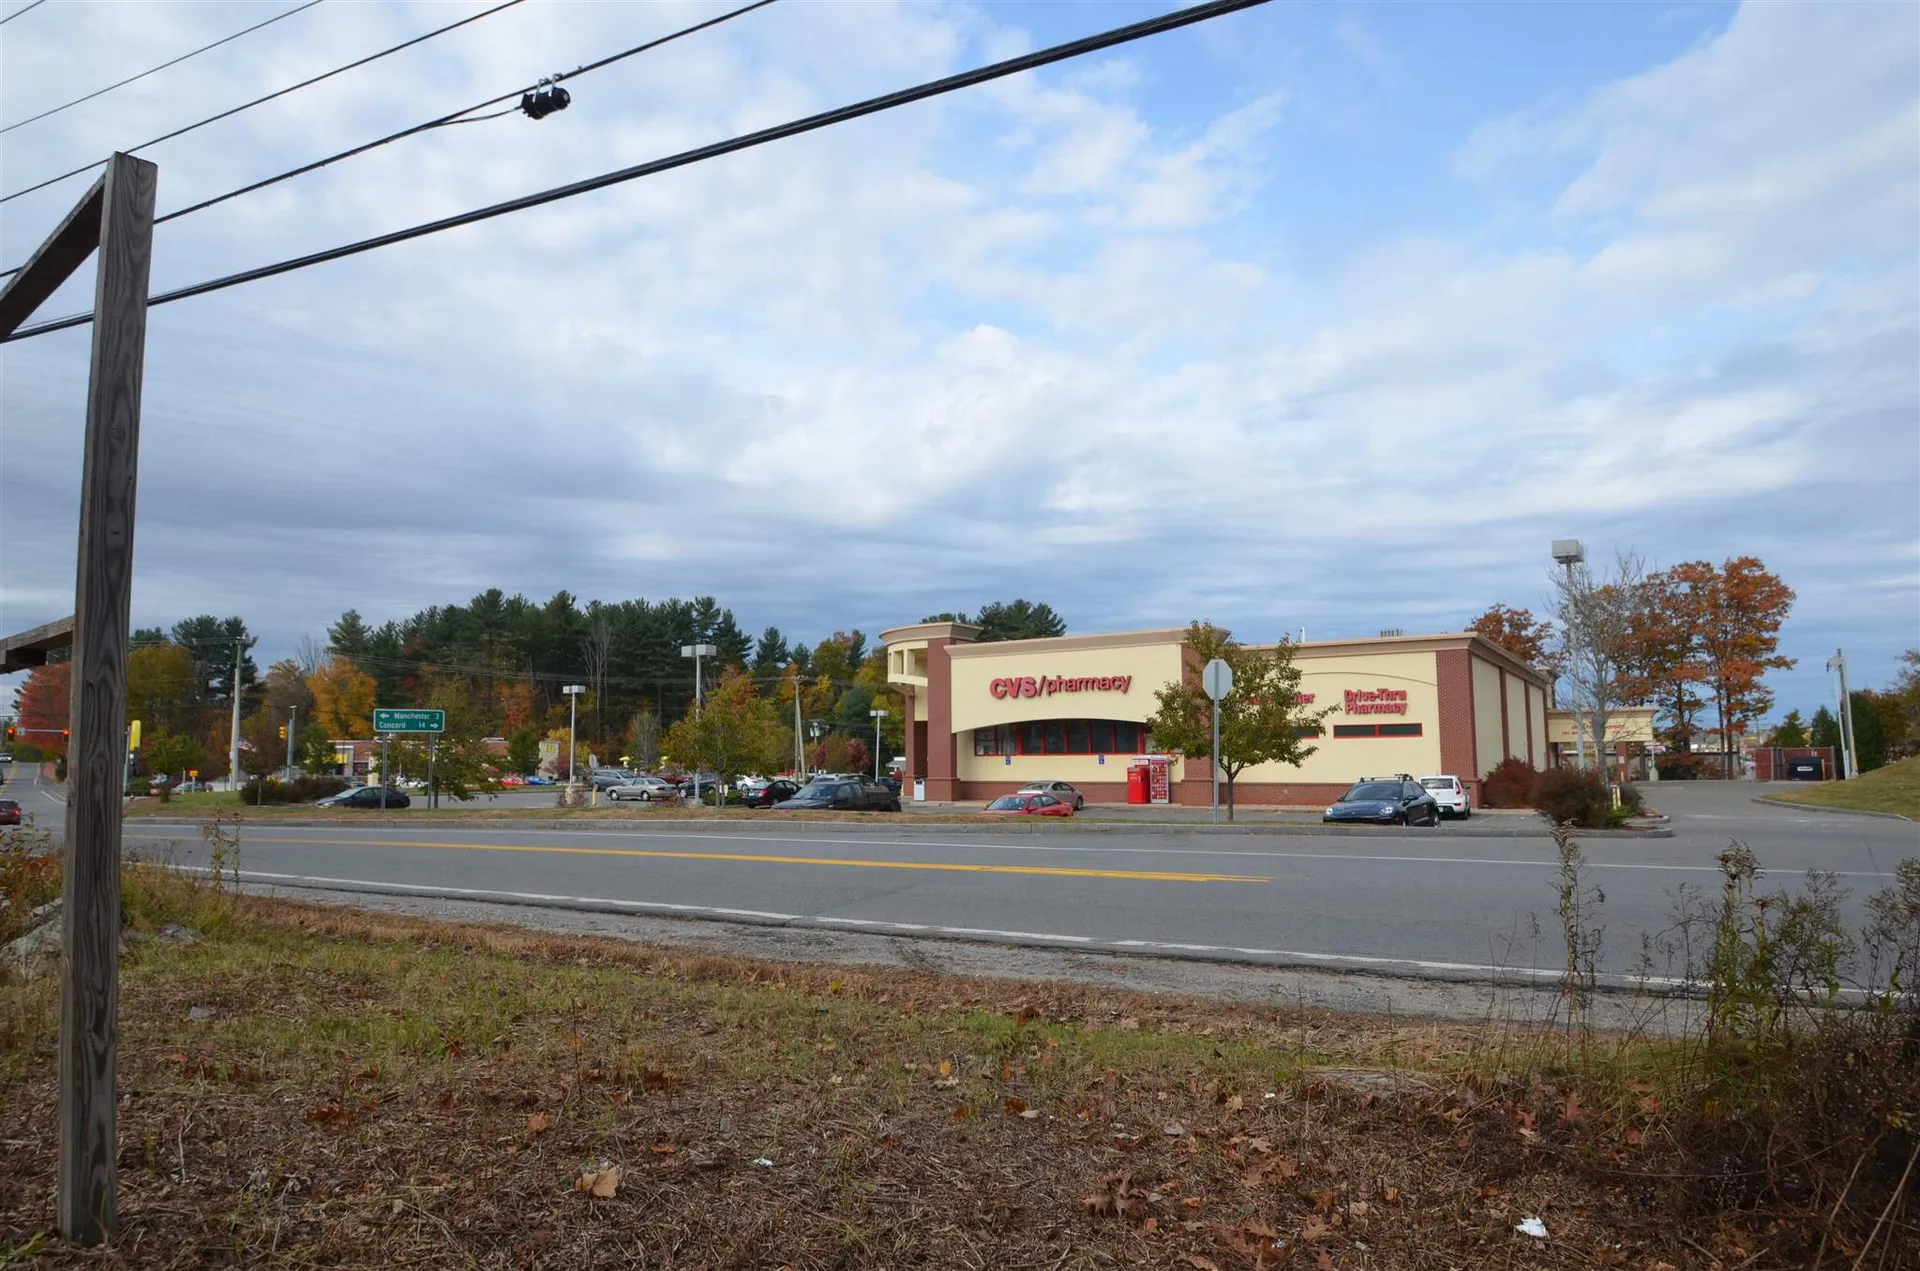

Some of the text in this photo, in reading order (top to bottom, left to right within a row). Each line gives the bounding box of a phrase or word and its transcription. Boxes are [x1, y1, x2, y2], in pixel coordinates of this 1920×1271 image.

[989, 675, 1132, 699] CVS/pharmacy
[1344, 688, 1407, 701] Drive-Thru
[1345, 701, 1408, 716] Pharmacy
